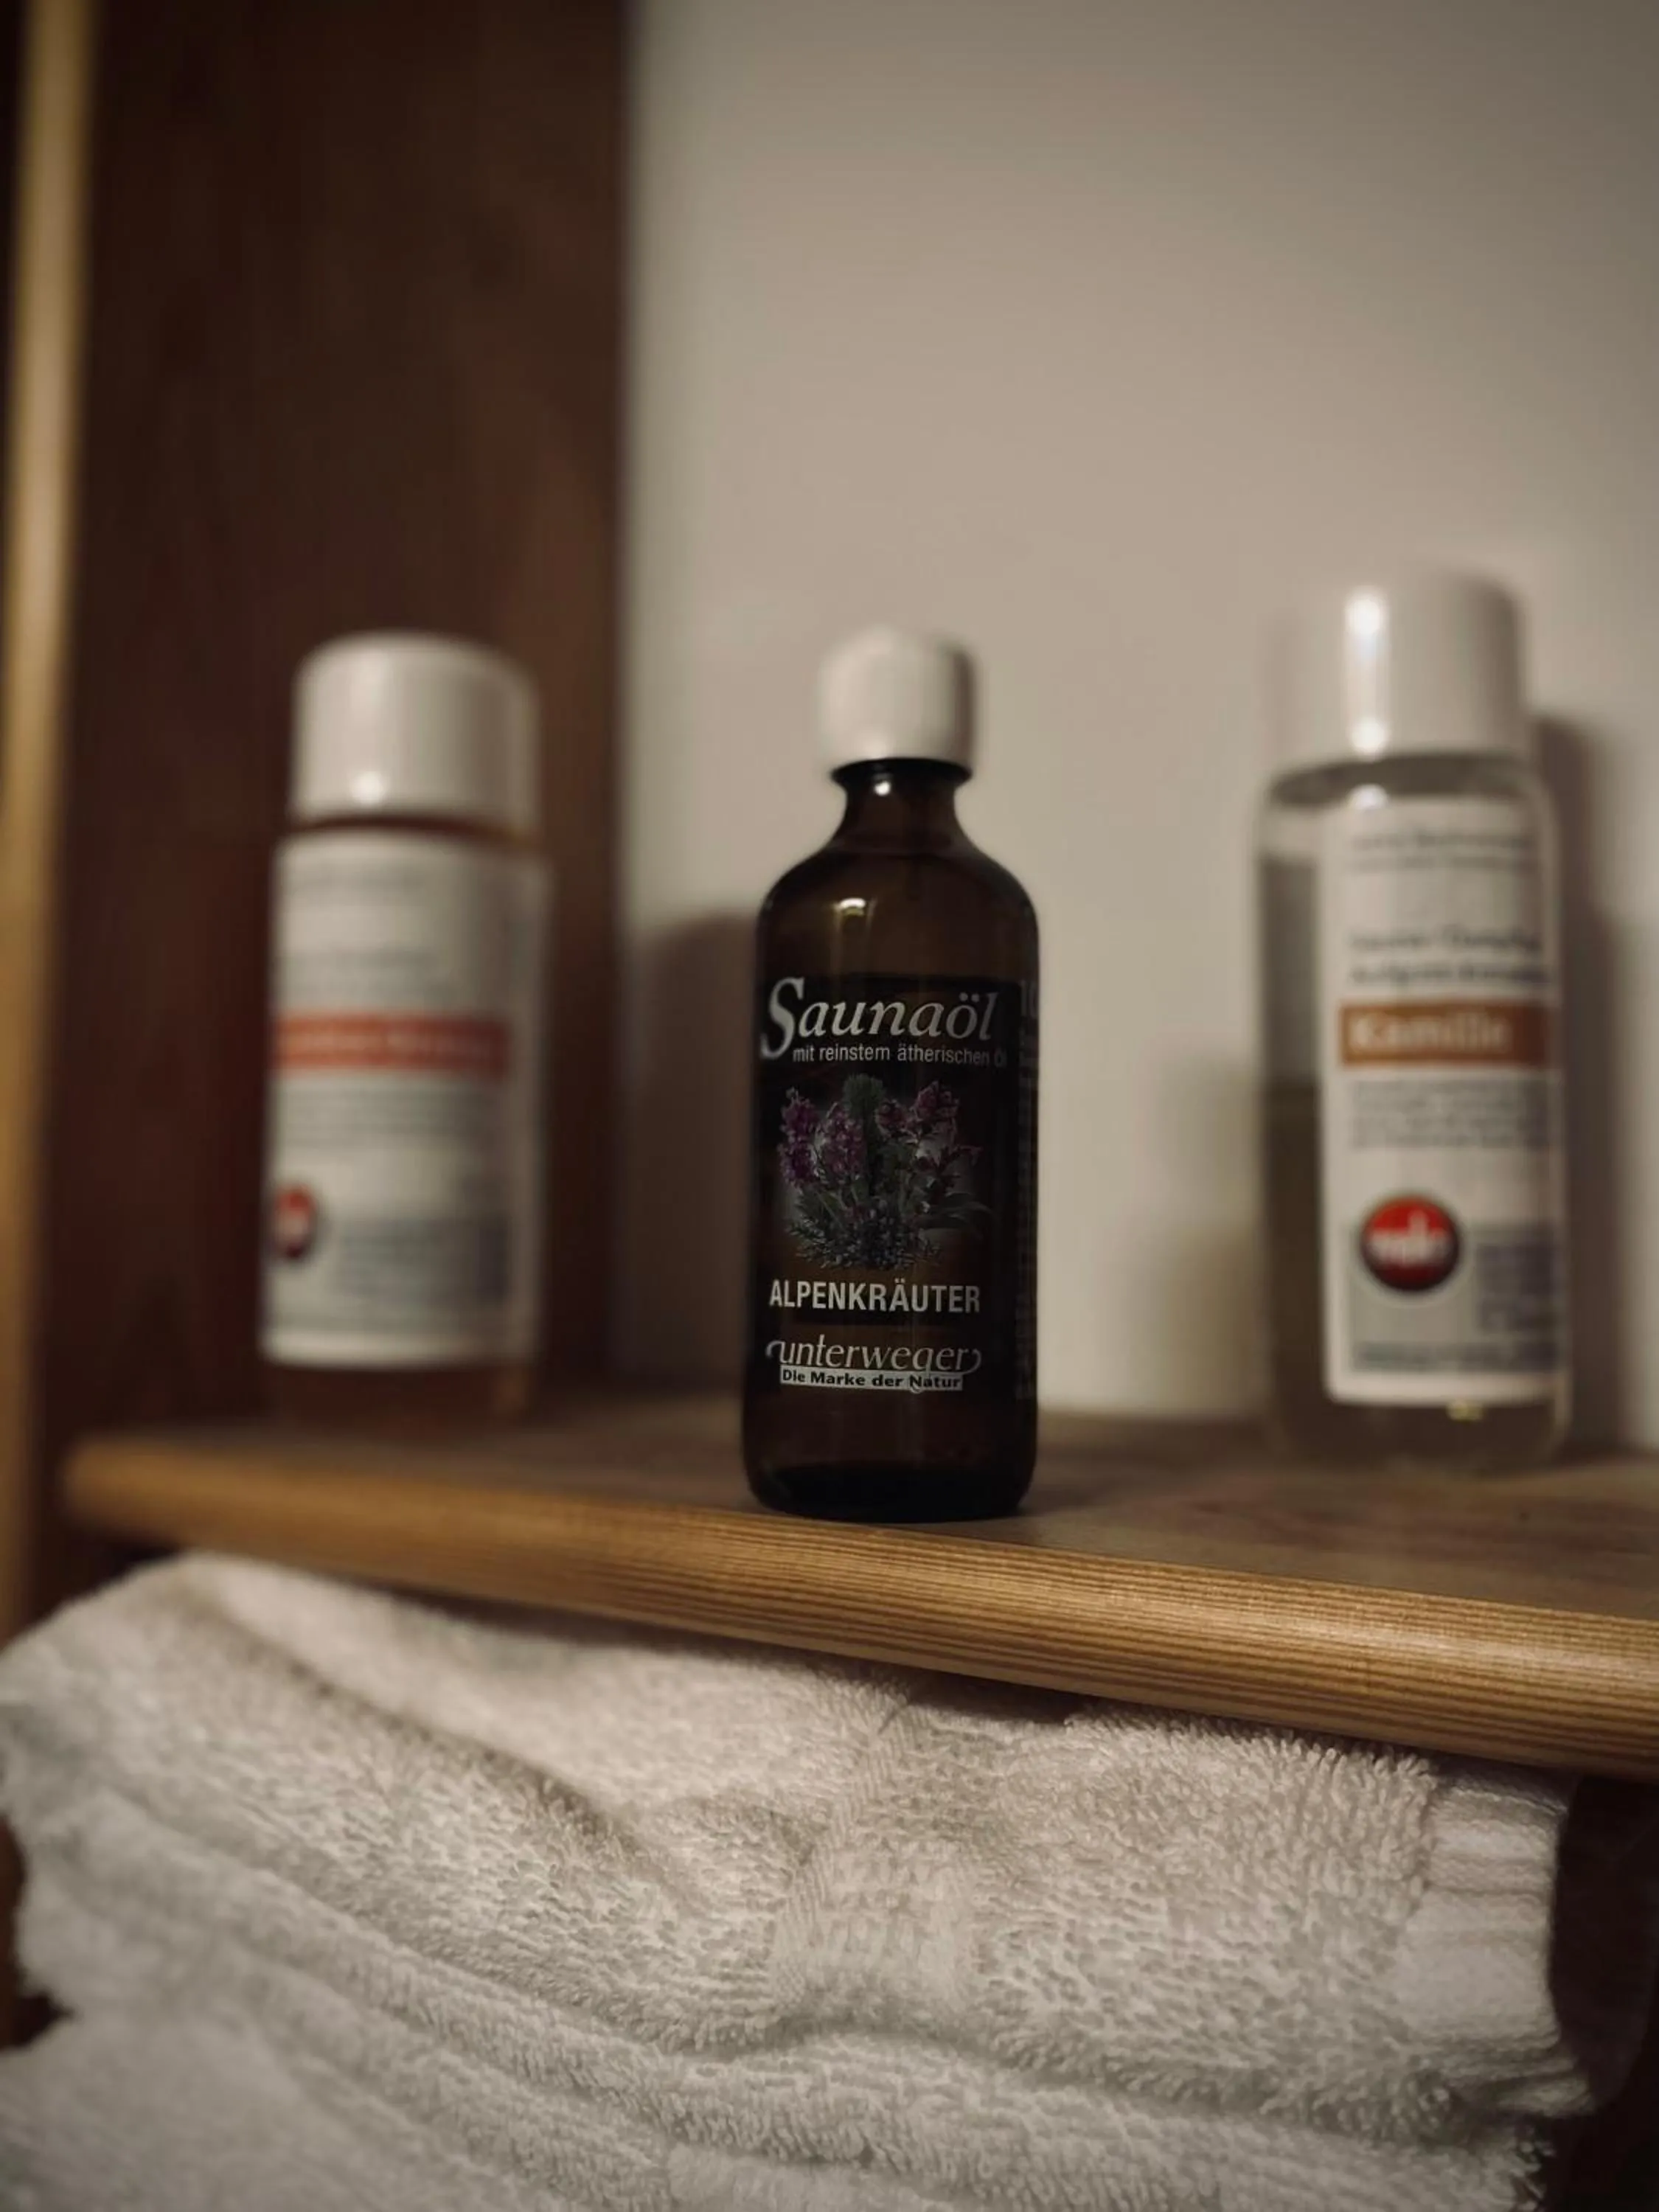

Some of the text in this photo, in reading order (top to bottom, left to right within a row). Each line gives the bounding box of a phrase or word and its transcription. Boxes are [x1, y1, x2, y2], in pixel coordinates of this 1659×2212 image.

[759, 976, 999, 1060] Saunaöl
[792, 1046, 815, 1062] mit
[819, 1043, 890, 1062] reinstem
[897, 1043, 990, 1065] ätherischen
[769, 1278, 981, 1313] ALPENKRÄUTER
[765, 1334, 982, 1391] unterweger
[782, 1368, 961, 1389] Die Marke der Natur
